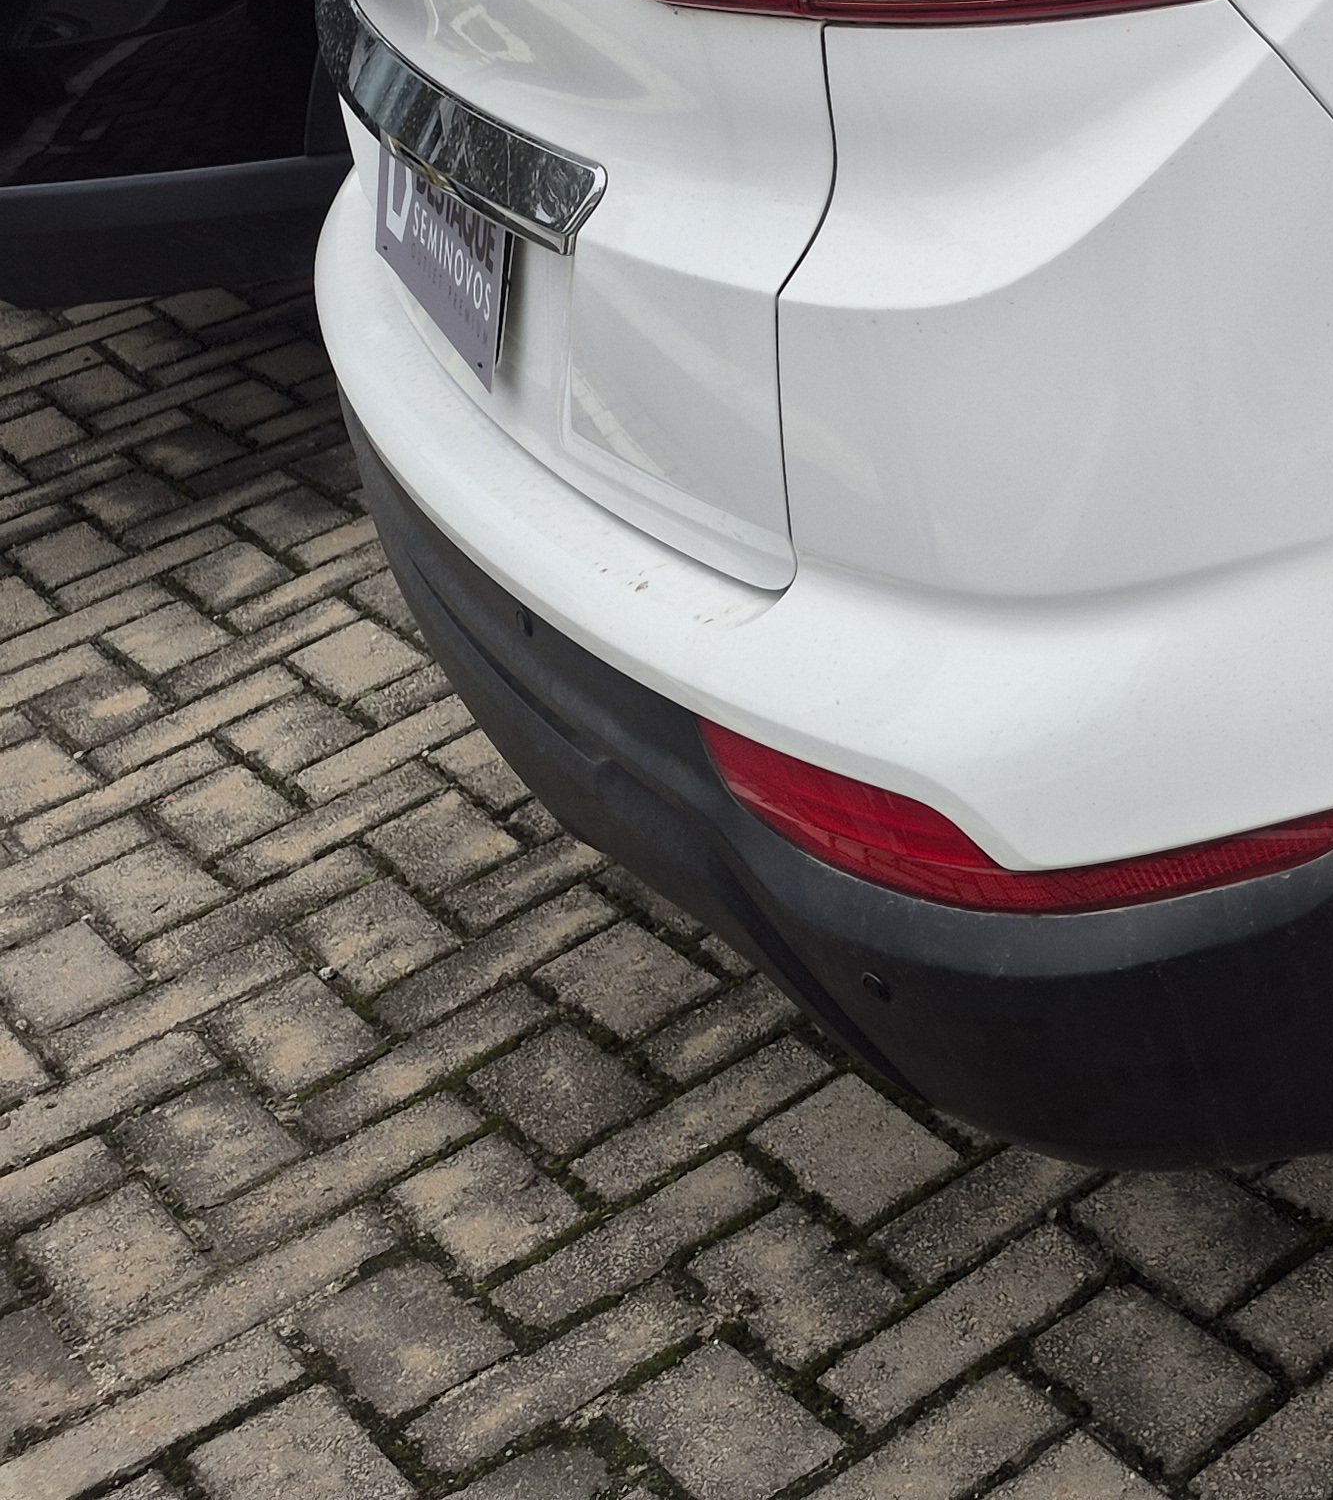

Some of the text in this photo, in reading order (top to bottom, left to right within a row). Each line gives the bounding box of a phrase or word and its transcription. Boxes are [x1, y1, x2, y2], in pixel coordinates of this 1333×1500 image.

[411, 242, 488, 347] OUTLET PREMIUM
[412, 201, 492, 322] SEMINOVOS
